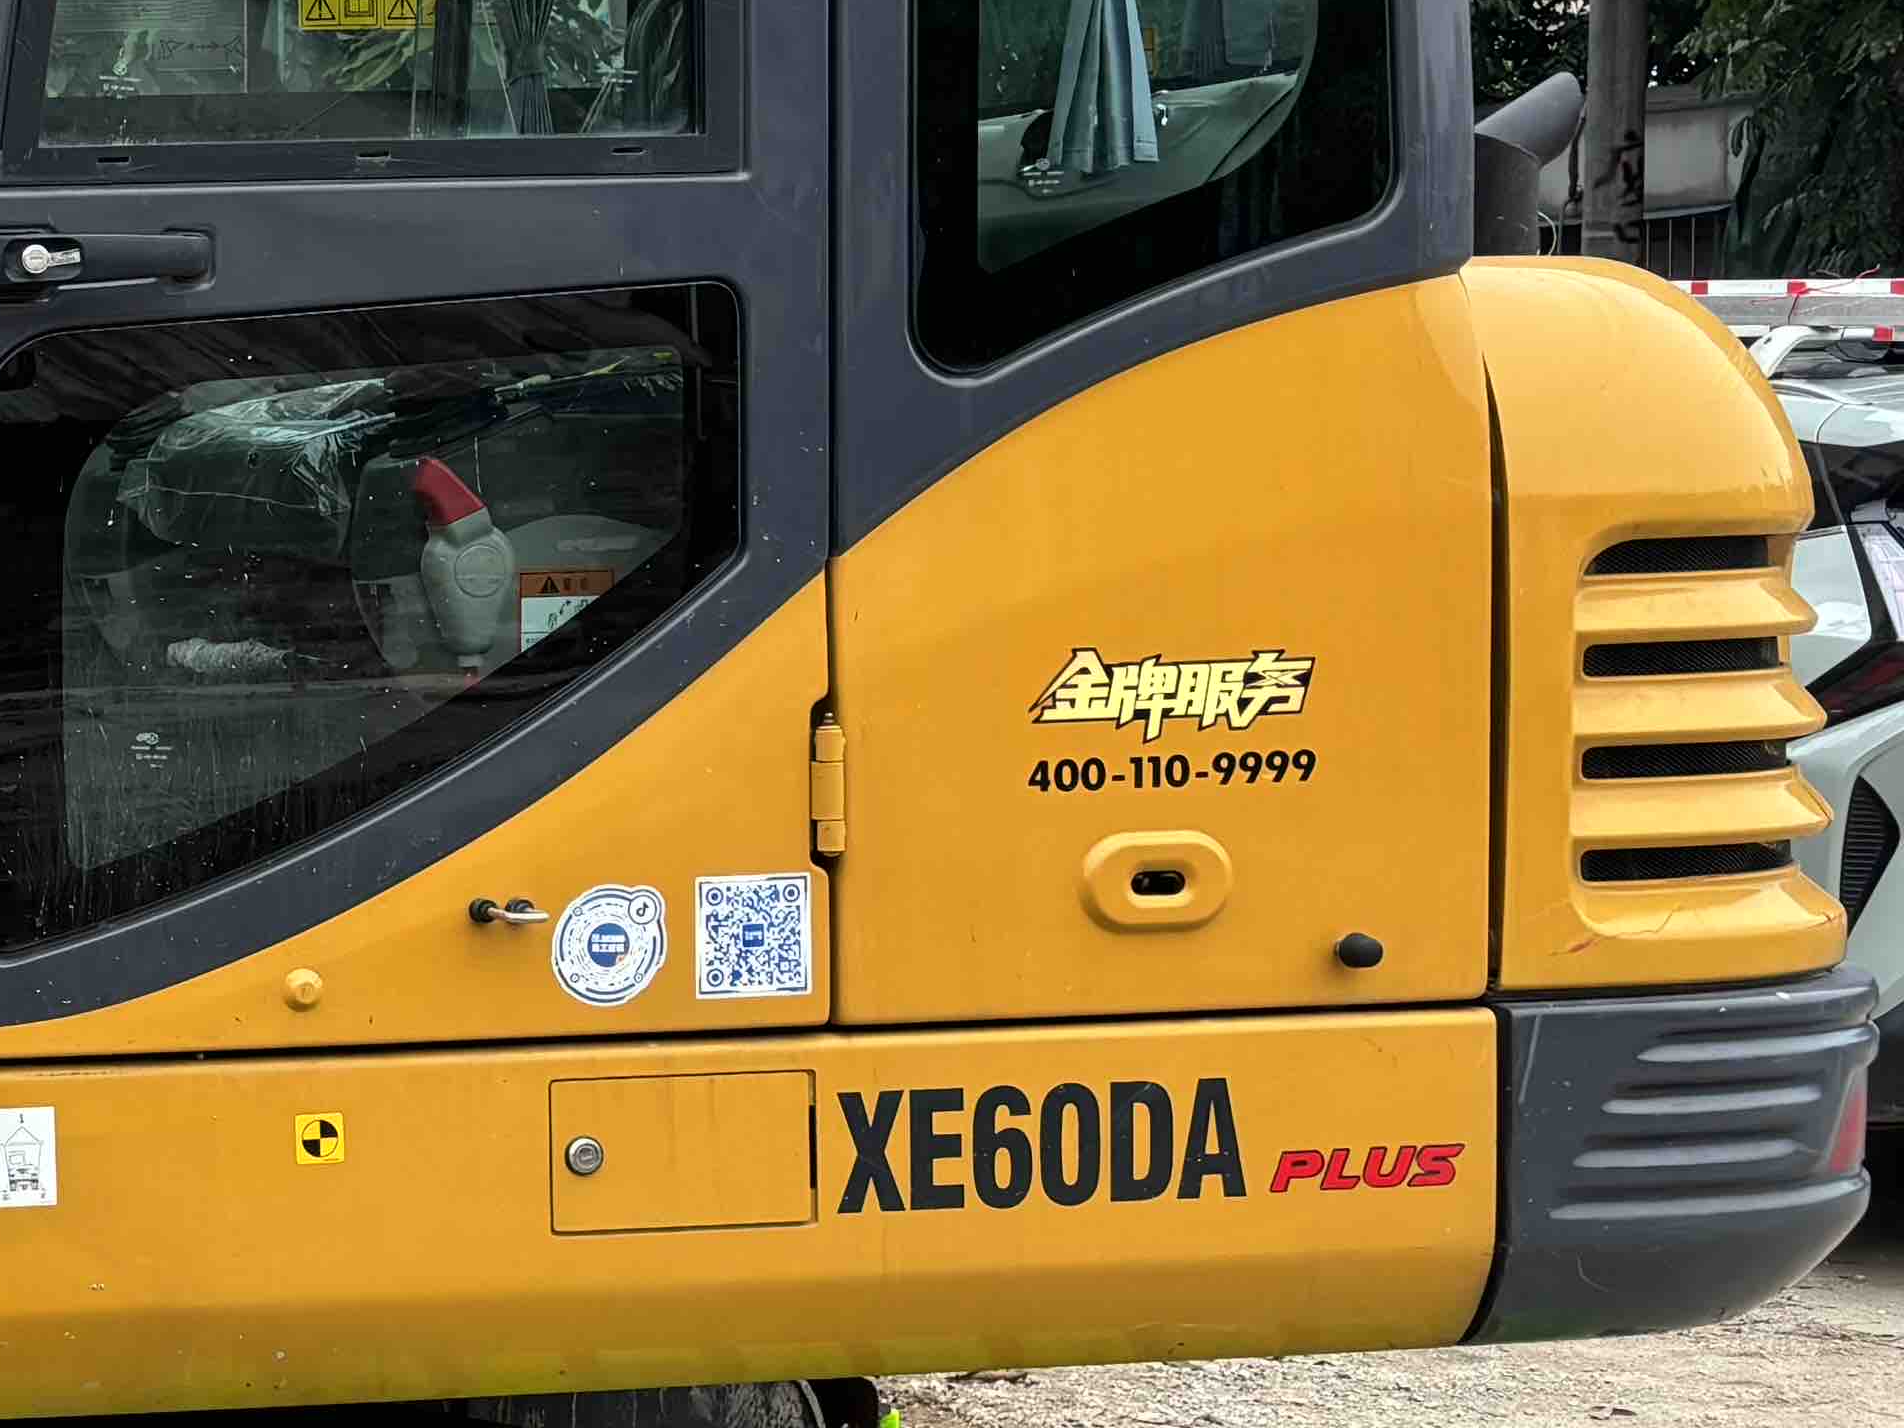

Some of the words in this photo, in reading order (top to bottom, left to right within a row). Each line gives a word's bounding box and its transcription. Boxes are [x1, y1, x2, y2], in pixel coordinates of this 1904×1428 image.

[1028, 647, 1316, 744] 金牌服务
[1028, 749, 1316, 792] 400-110-9999
[837, 1077, 1247, 1213] XE60DA
[1270, 1143, 1465, 1193] PLUS
